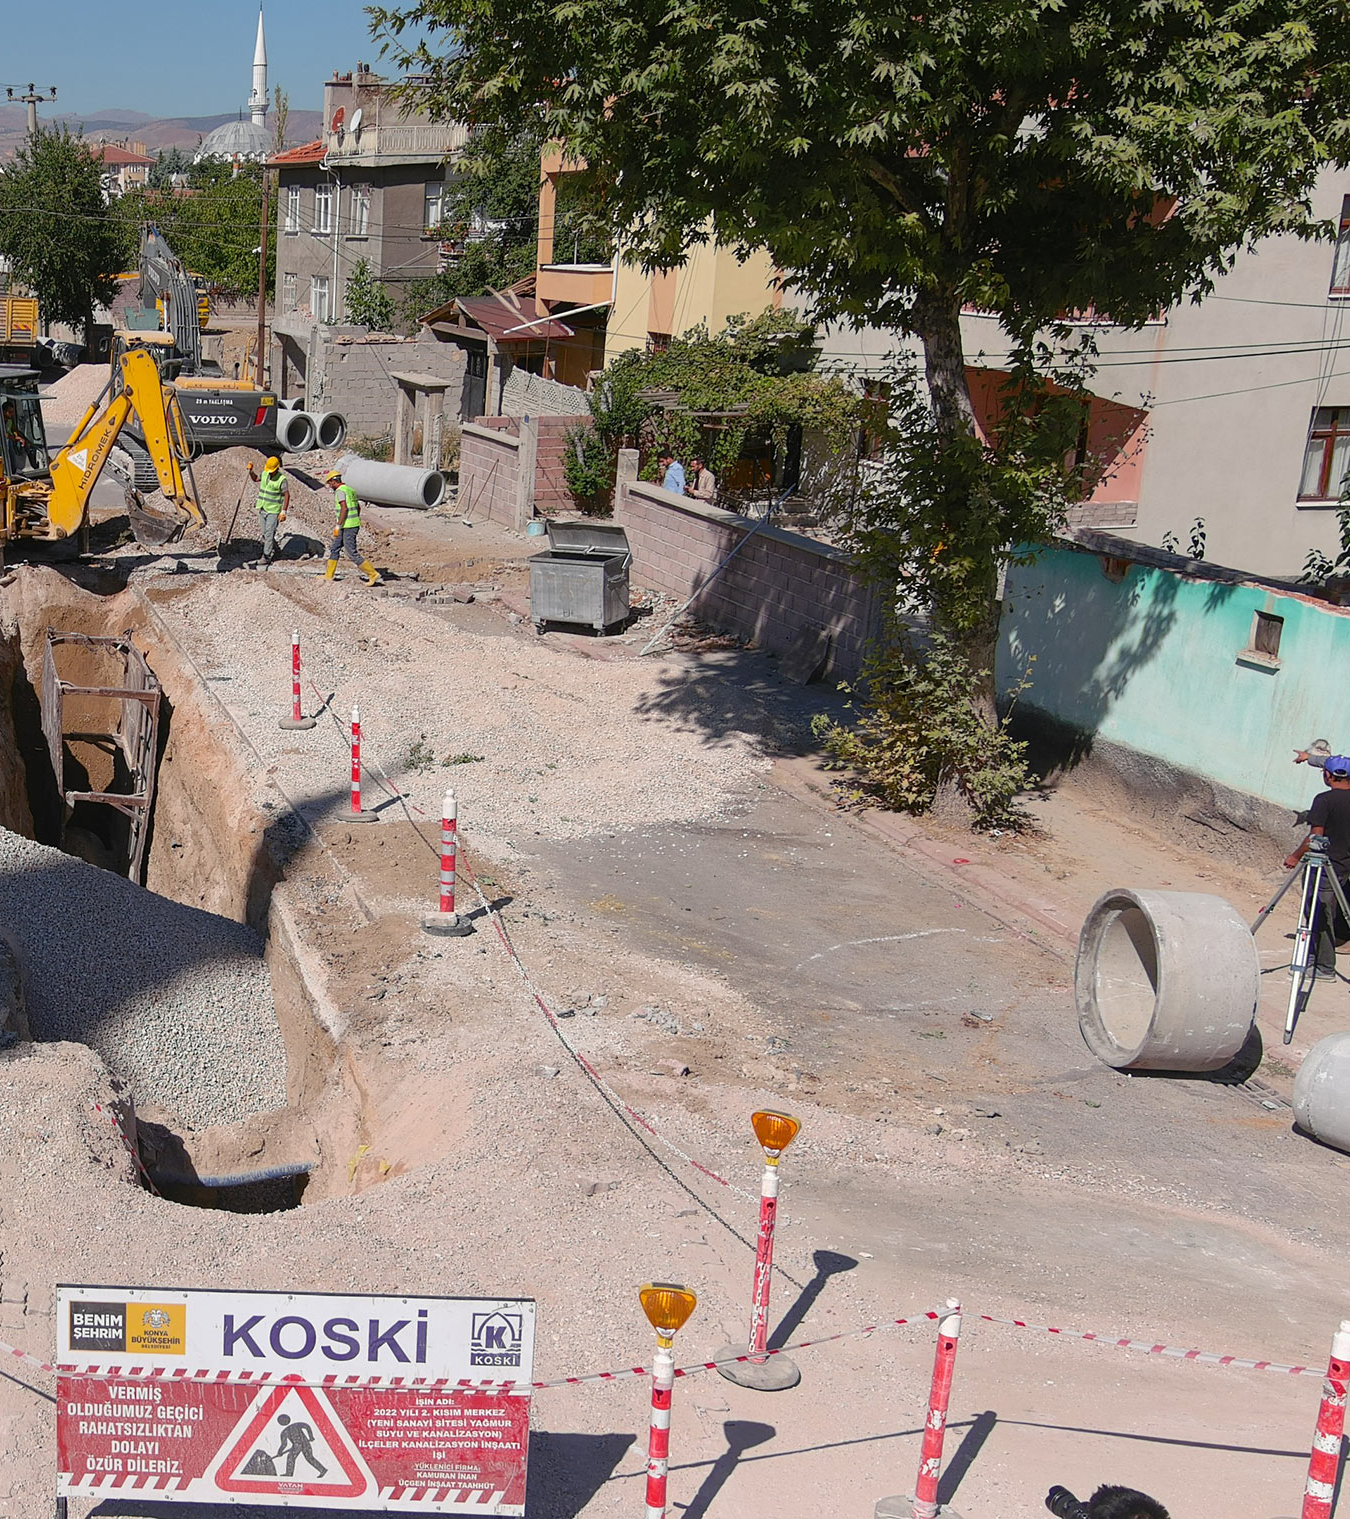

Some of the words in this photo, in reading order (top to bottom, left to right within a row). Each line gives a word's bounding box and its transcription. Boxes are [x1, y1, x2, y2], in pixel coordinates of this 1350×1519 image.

[189, 415, 238, 424] VOLVO
[73, 1313, 123, 1327] BENİM
[73, 1327, 123, 1340] ŞEHRİM
[144, 1330, 168, 1338] KONYA
[223, 1309, 428, 1363] KOSKİ
[474, 1354, 517, 1366] KOSKİ
[109, 1385, 162, 1403] VERMİŞ
[415, 1397, 435, 1407] İŞİN
[436, 1398, 455, 1406] ADI:
[67, 1401, 153, 1418] OLDUĞUMUZ
[157, 1404, 204, 1422] GEÇİCİ
[374, 1409, 397, 1417] 2022
[399, 1409, 419, 1417] YILI
[422, 1409, 430, 1417] 2.
[433, 1409, 461, 1417] KISIM
[464, 1409, 506, 1417] MERKEZ
[367, 1418, 394, 1428] (YENİ
[396, 1419, 433, 1427] SANAYİ
[435, 1419, 467, 1427] SİTESİ
[469, 1418, 512, 1428] YAĞMUR
[79, 1421, 192, 1438] RAHATSIZLIKTAN
[376, 1430, 404, 1438] SUYU
[406, 1430, 420, 1438] VE
[422, 1429, 503, 1439] KANALİZASYON)
[111, 1440, 159, 1455] DOLAYI
[358, 1439, 399, 1450] İLÇELER
[401, 1440, 479, 1449] KANALİZASYON
[481, 1440, 521, 1450] İNŞAATI
[86, 1454, 123, 1471] ÖZÜR
[127, 1457, 183, 1474] DİLERİZ.
[414, 1462, 454, 1470] YÜKLENİCİ
[416, 1471, 456, 1480] KAMURAN
[457, 1472, 478, 1480] İNAN
[398, 1478, 426, 1488] ÜÇGEN
[427, 1479, 455, 1489] İNŞAAT
[458, 1481, 495, 1490] TAAHHÜT
